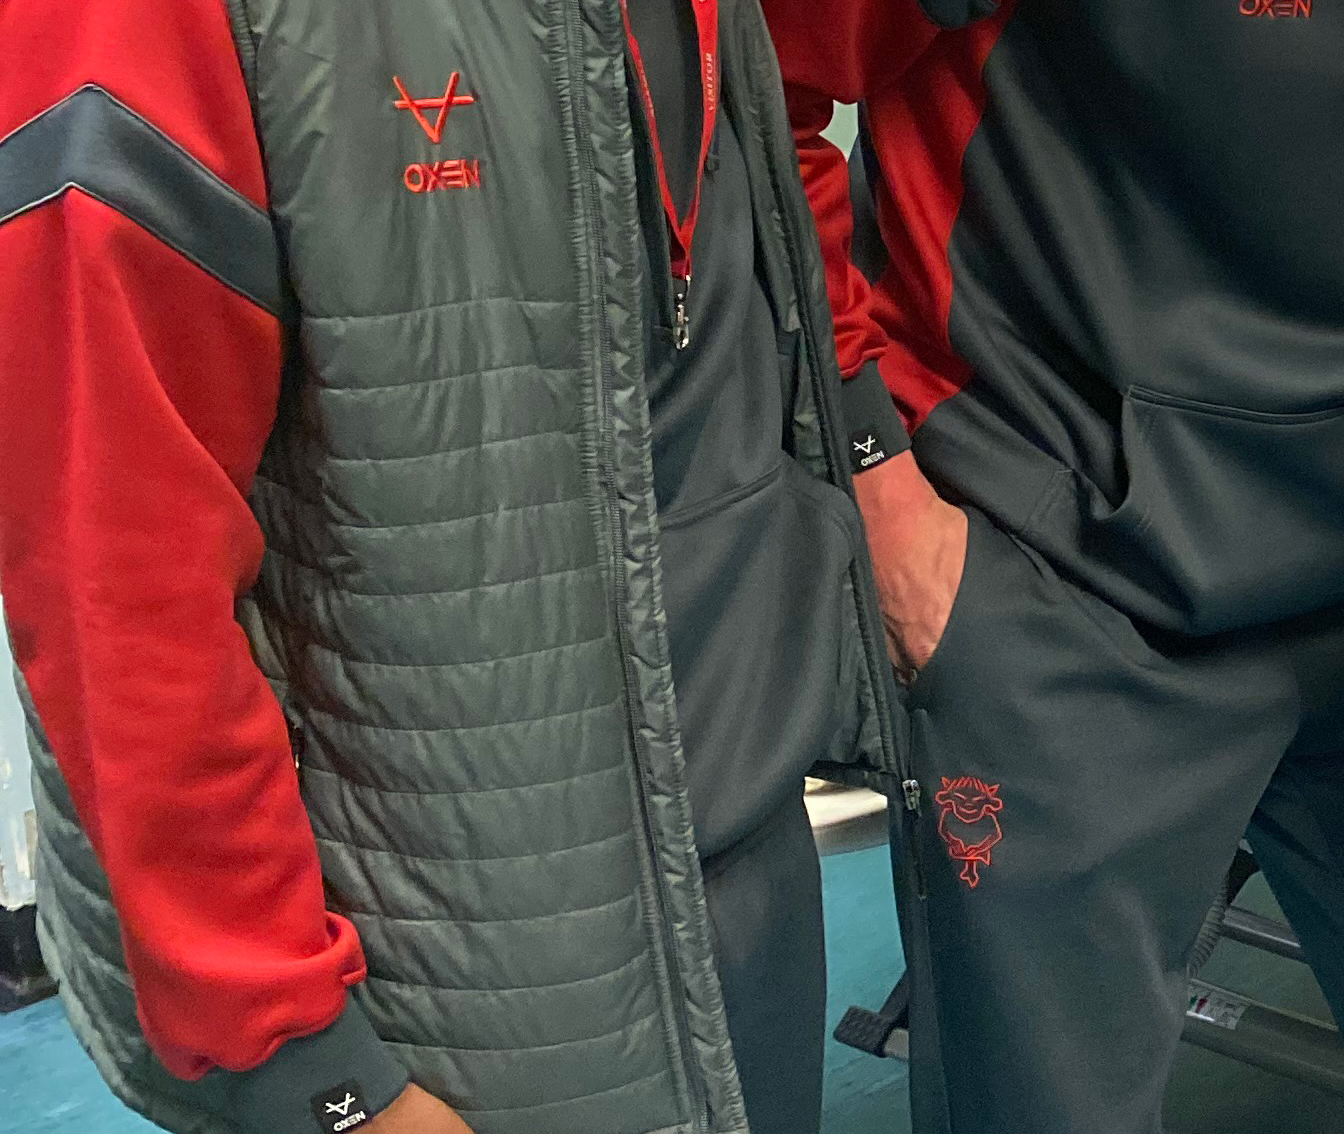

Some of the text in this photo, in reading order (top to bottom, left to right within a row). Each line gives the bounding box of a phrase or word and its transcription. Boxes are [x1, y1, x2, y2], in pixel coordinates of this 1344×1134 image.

[704, 53, 714, 111] VISITOR
[404, 158, 480, 193] OXEN
[860, 450, 885, 467] OXEN
[333, 1110, 366, 1132] OXEN
